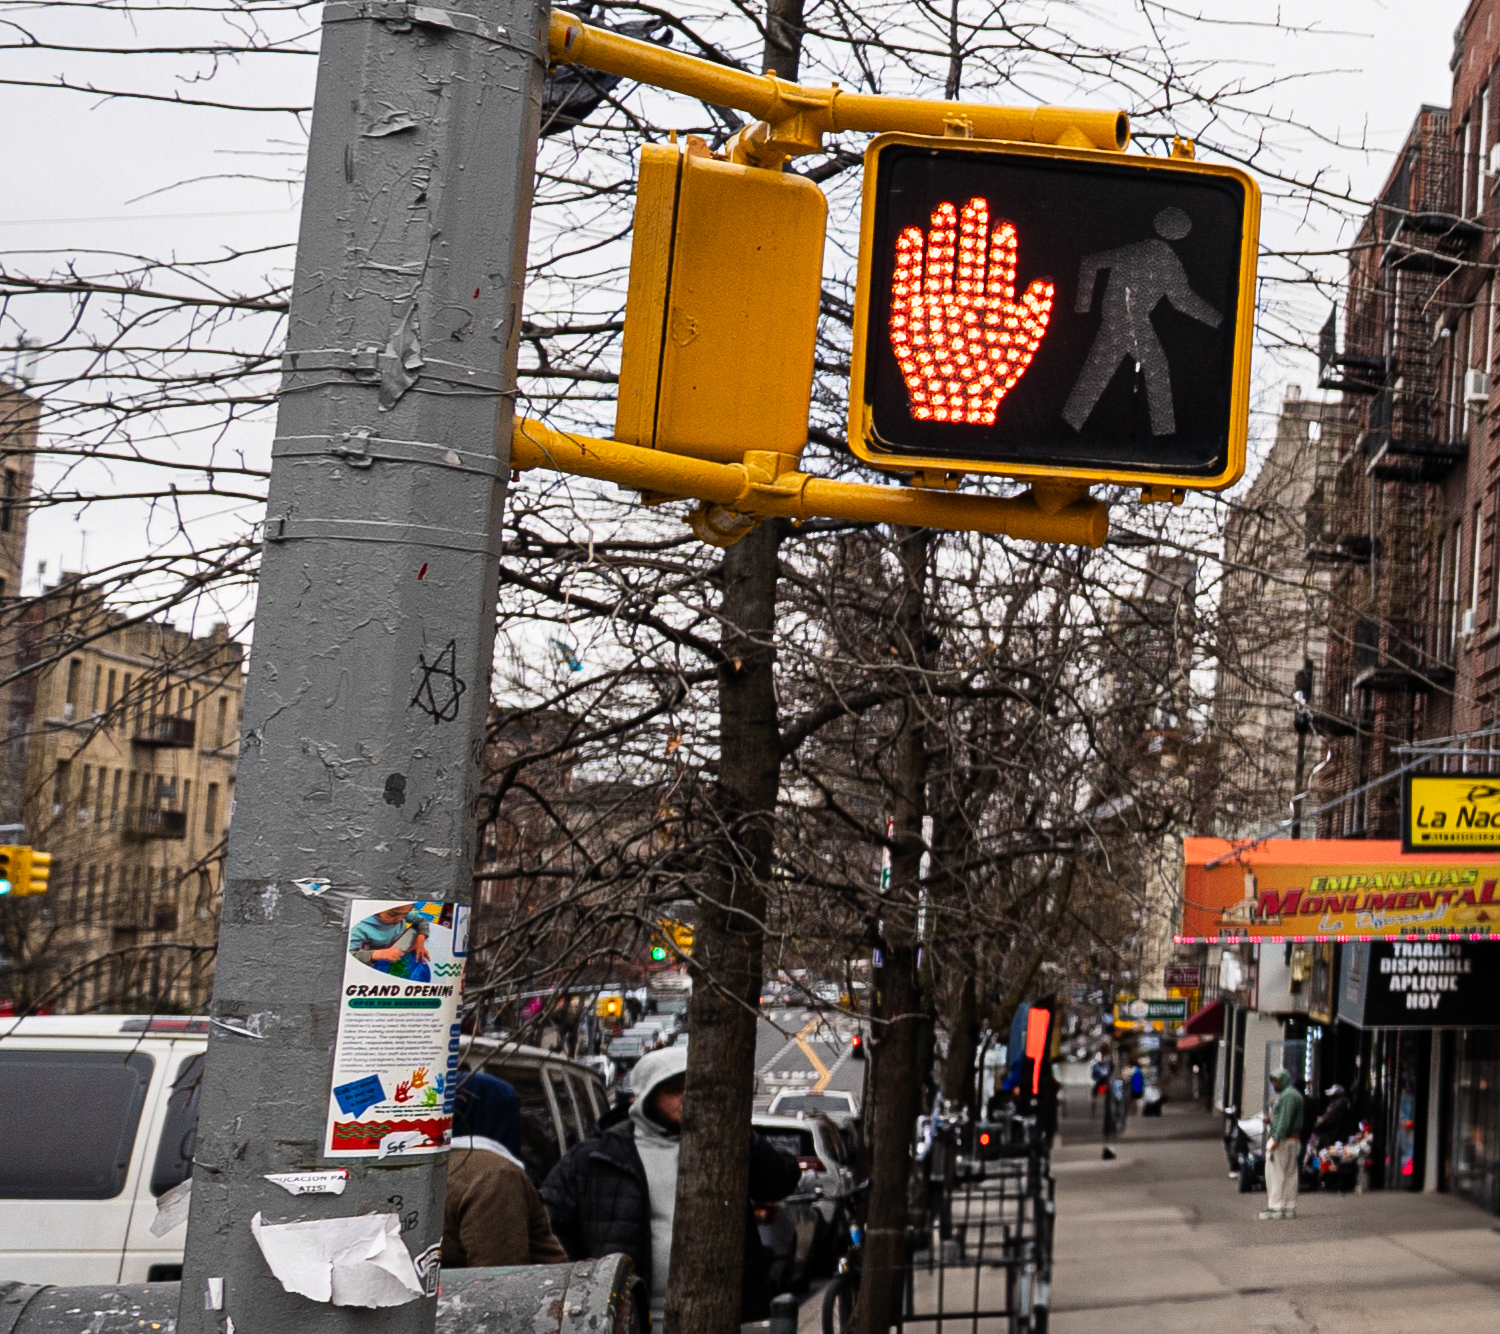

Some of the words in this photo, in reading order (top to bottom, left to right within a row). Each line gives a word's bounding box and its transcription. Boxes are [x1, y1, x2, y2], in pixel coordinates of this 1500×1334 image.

[1416, 805, 1447, 829] La
[1309, 869, 1478, 894] EMPANADAS
[1393, 942, 1462, 956] TRABAJO
[1380, 958, 1472, 974] DISPONIBLE
[345, 984, 400, 997] GRAND
[404, 984, 453, 998] OPENING
[1390, 975, 1458, 991] APLIQUE
[1406, 993, 1441, 1009] HOY
